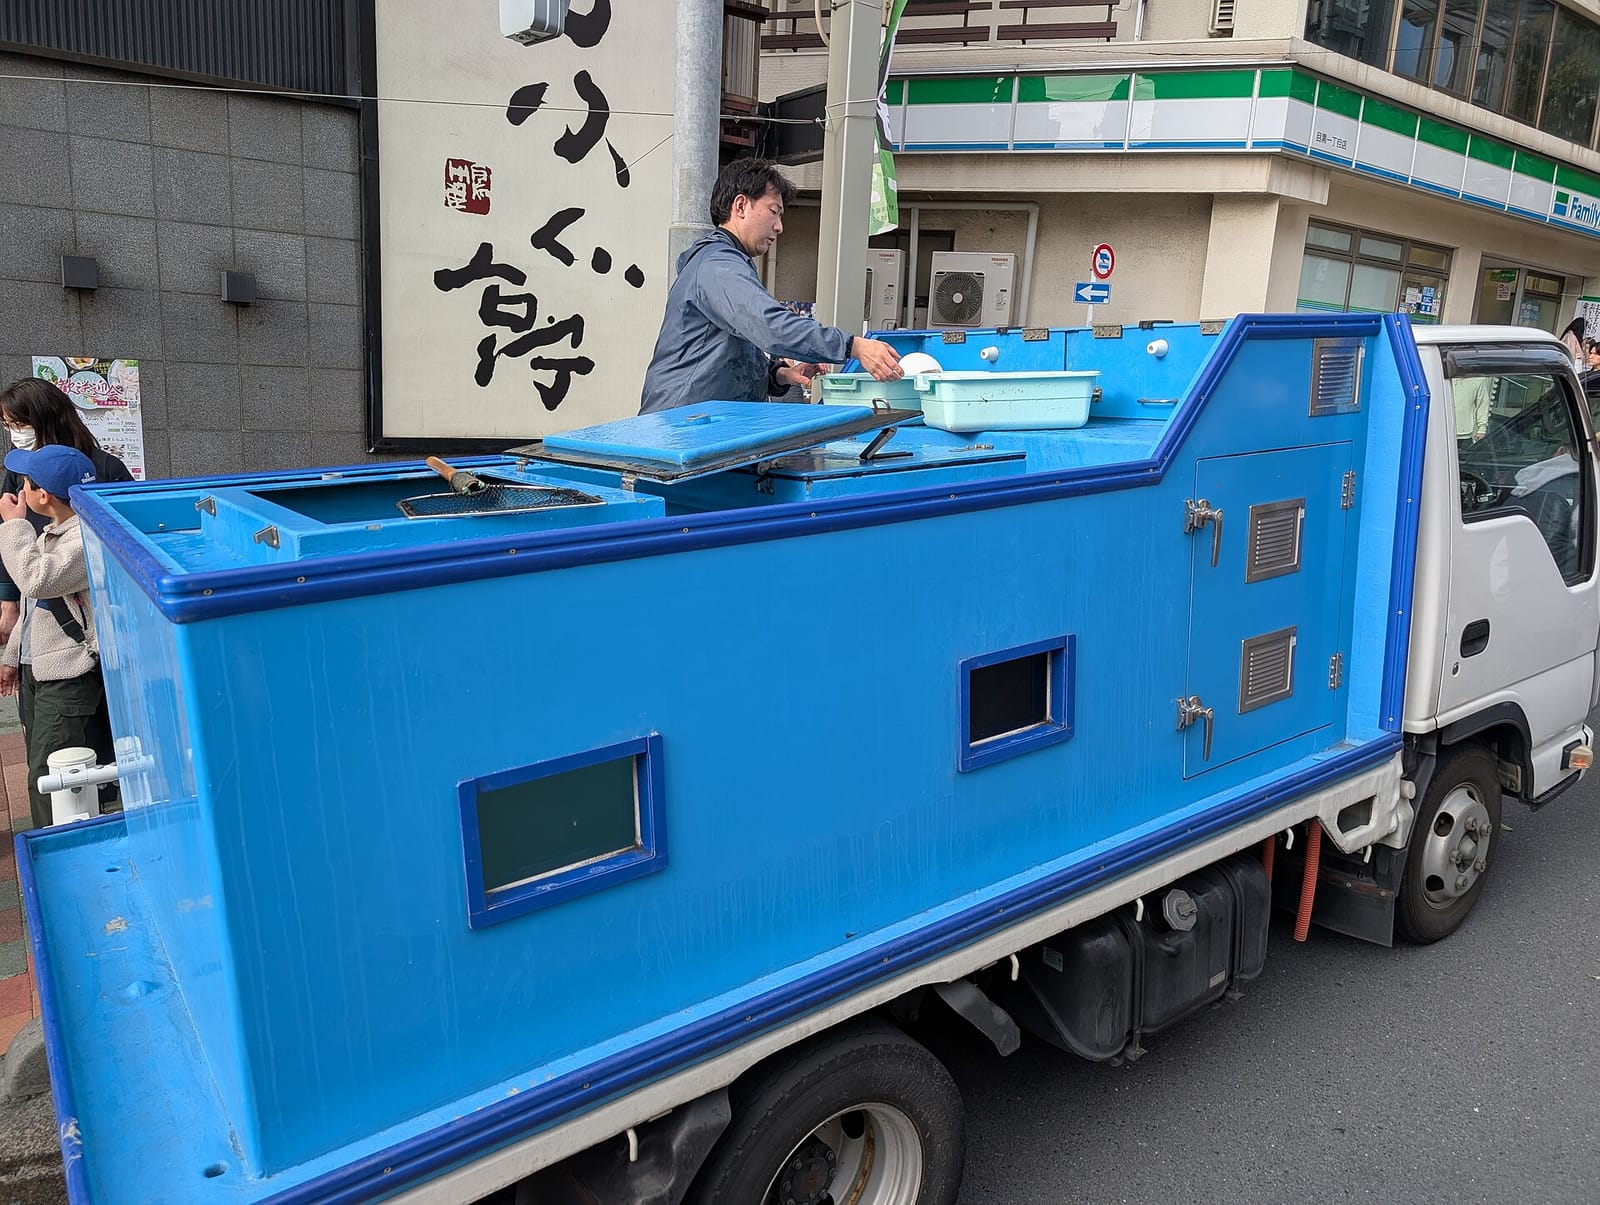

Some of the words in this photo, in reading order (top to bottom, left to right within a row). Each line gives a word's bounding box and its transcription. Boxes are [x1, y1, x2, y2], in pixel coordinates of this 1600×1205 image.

[1315, 131, 1348, 150] 目黒一丁目店
